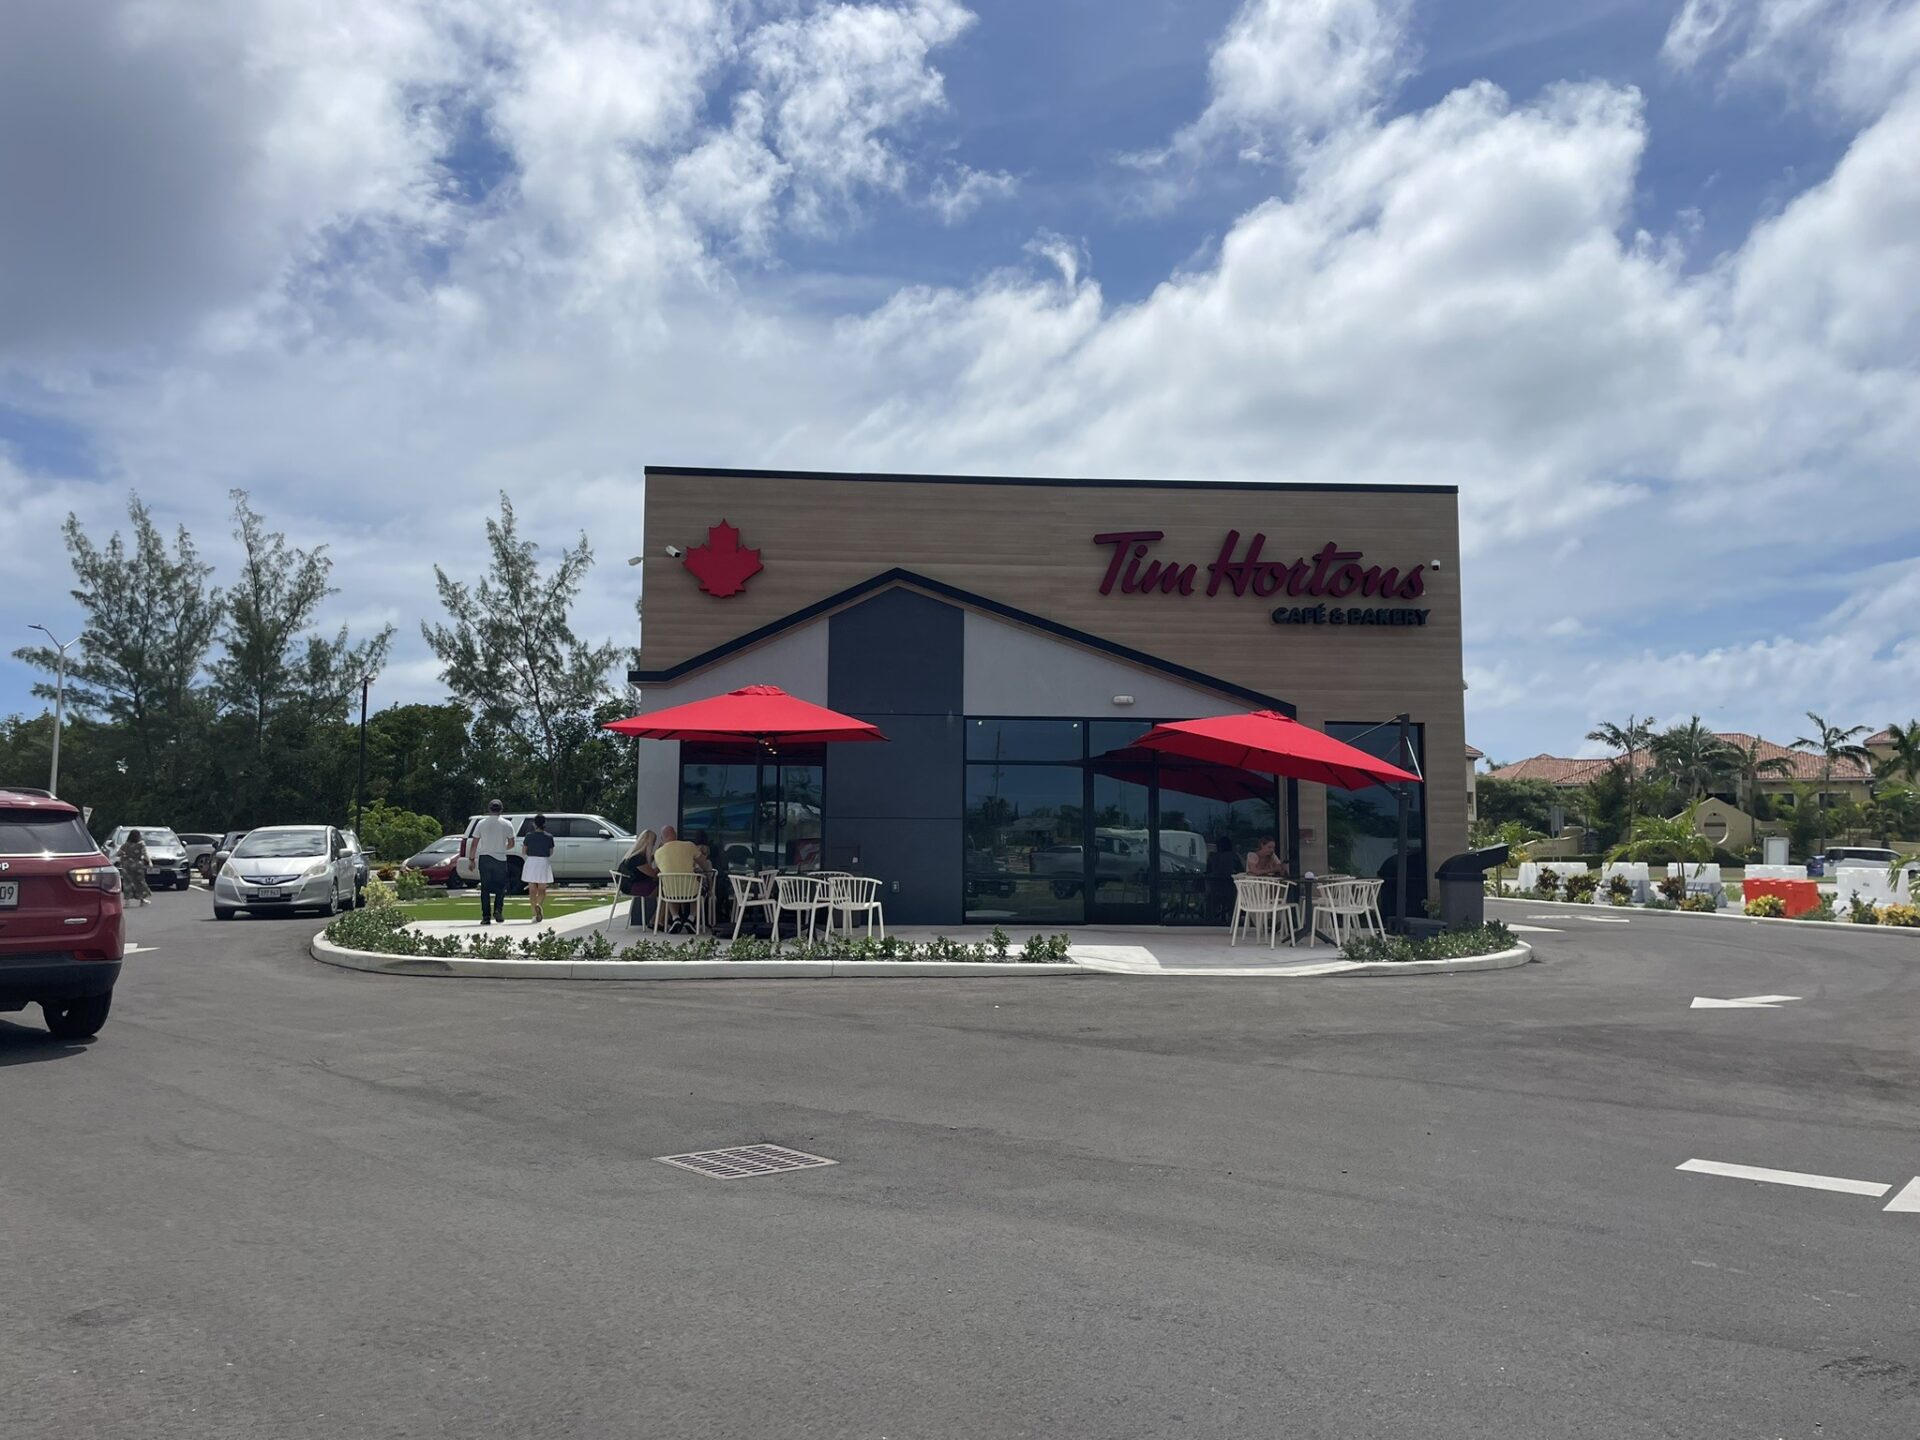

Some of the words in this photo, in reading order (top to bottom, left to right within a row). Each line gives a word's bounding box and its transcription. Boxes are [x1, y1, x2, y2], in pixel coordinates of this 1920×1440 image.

[1093, 530, 1197, 595] Tim
[1206, 529, 1425, 598] Hortons
[1272, 603, 1326, 624] CAFÉ
[1329, 608, 1346, 624] &
[1347, 608, 1431, 625] BAKERY
